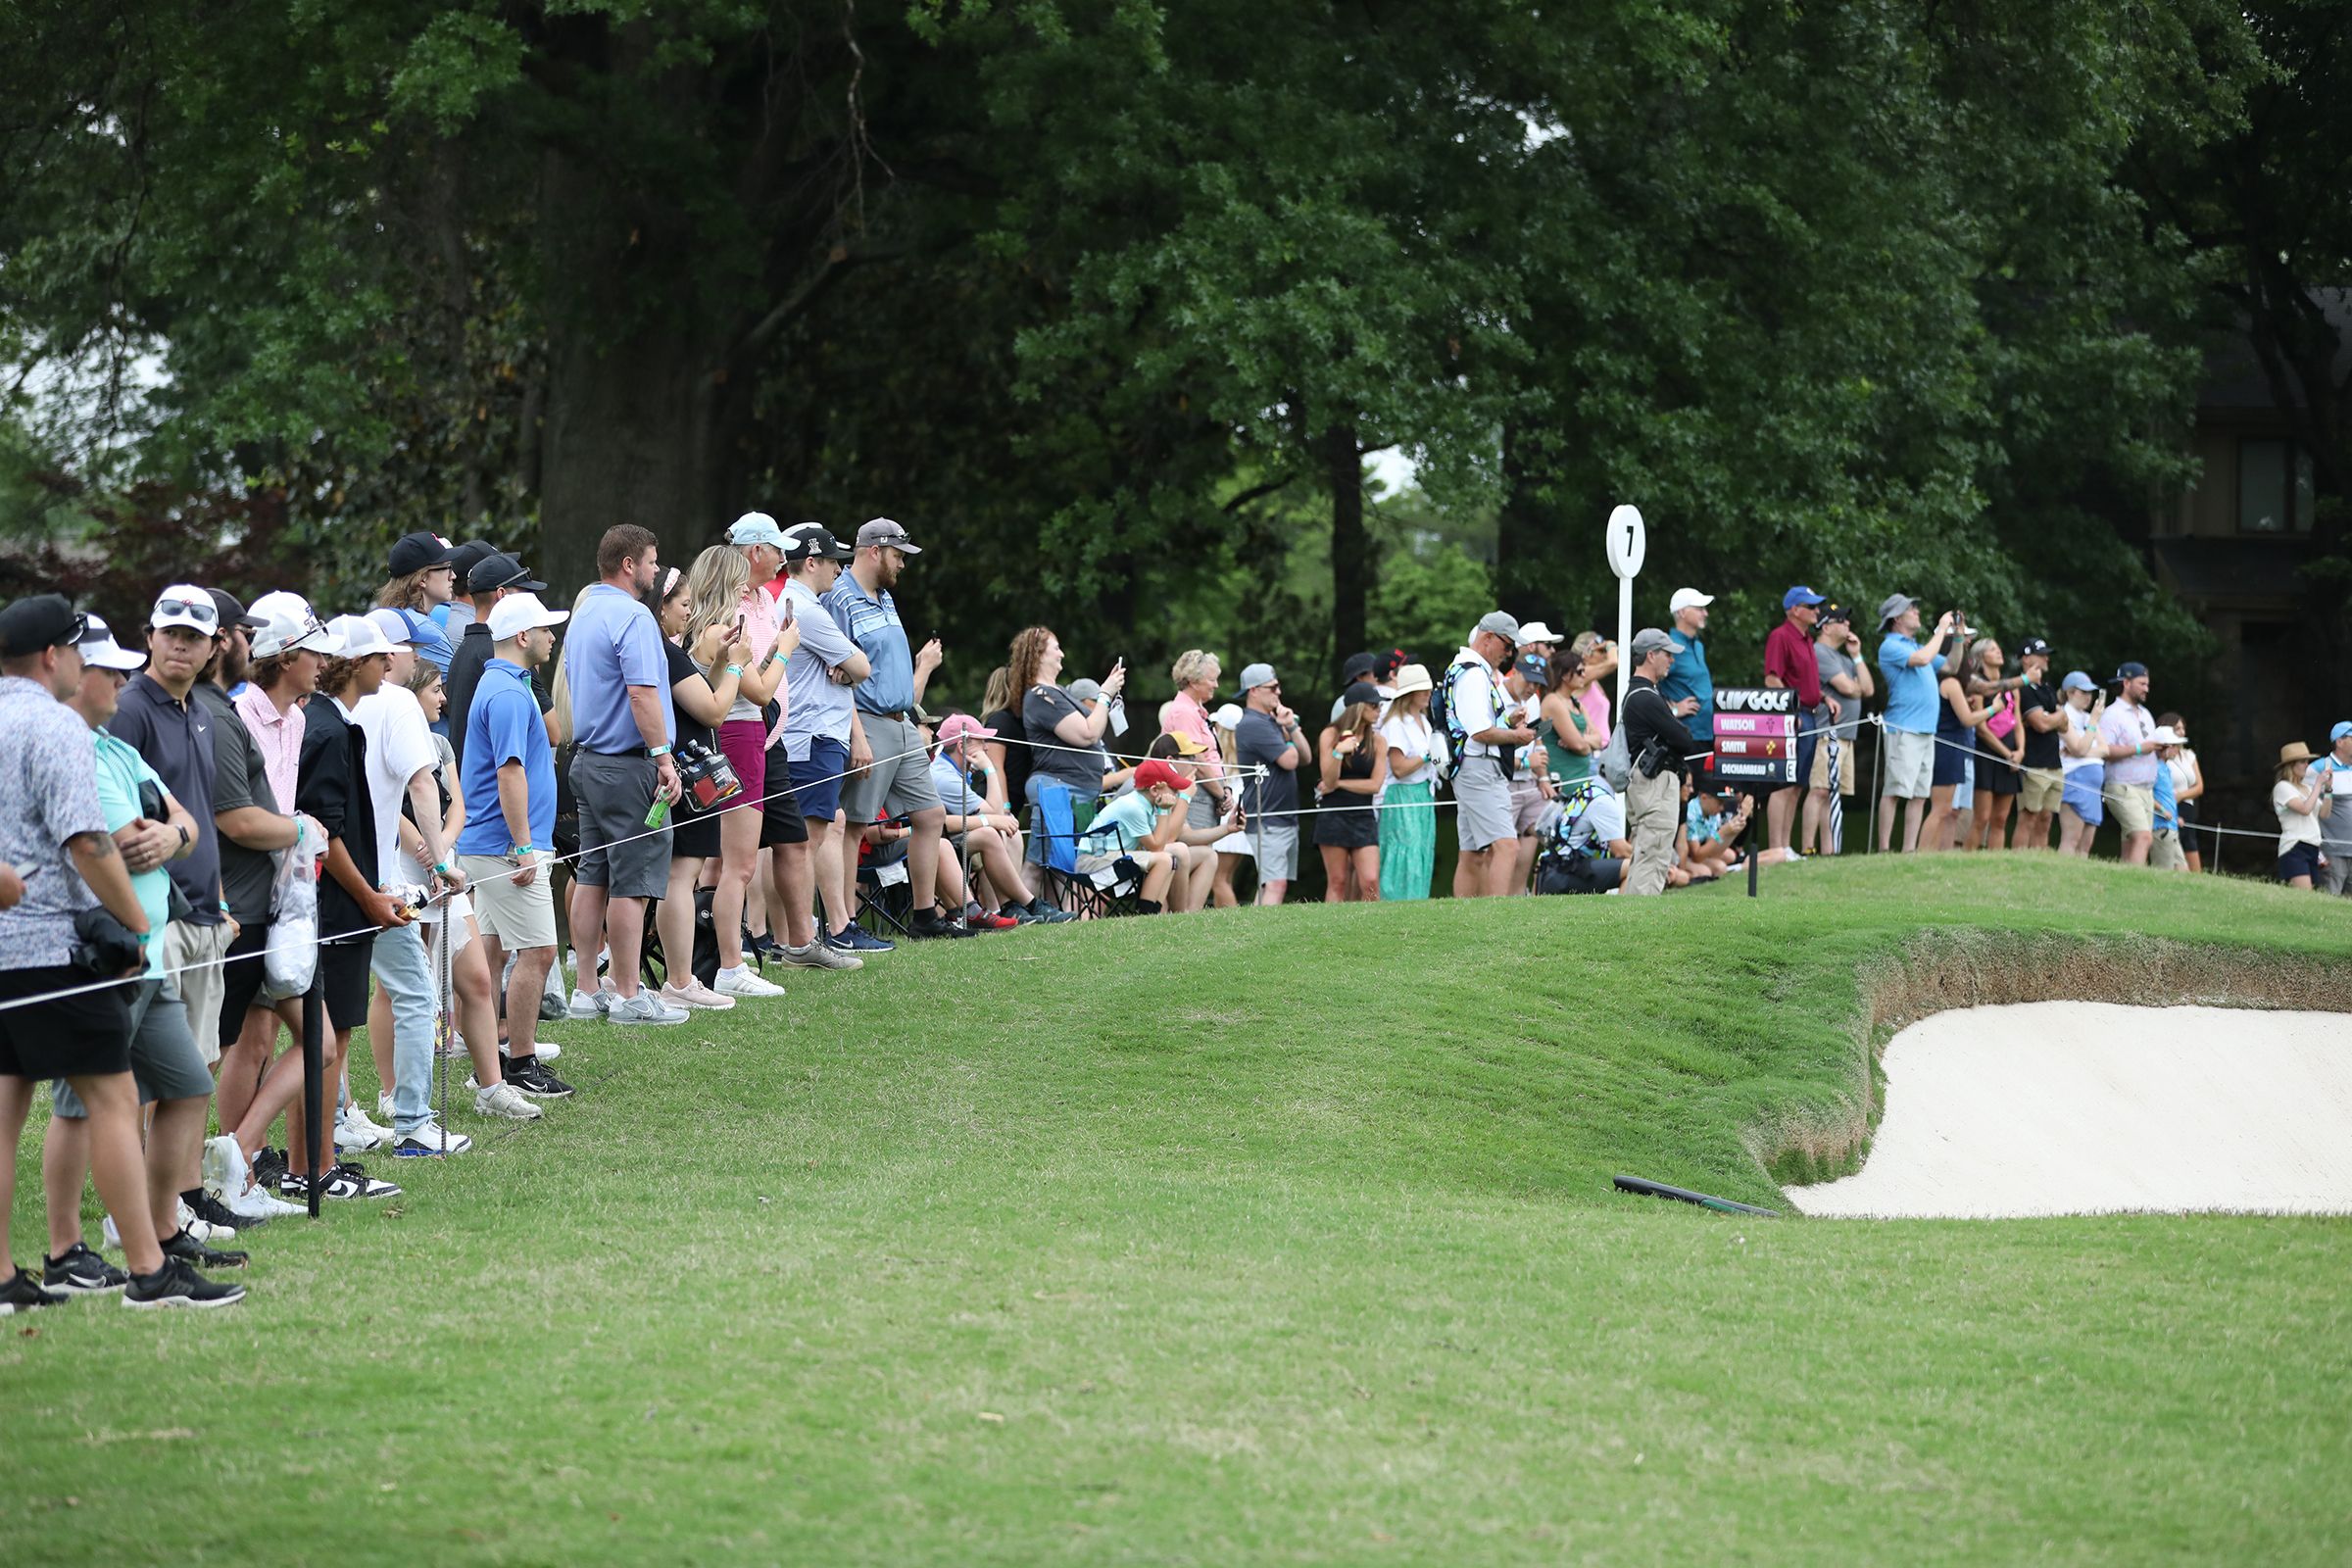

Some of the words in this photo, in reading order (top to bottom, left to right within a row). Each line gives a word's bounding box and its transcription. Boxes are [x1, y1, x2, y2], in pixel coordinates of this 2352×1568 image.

[1627, 525, 1634, 557] 7
[1720, 718, 1755, 731] WATSON
[1721, 741, 1746, 753] SMITH
[1721, 763, 1766, 775] DECHAMBEAU
